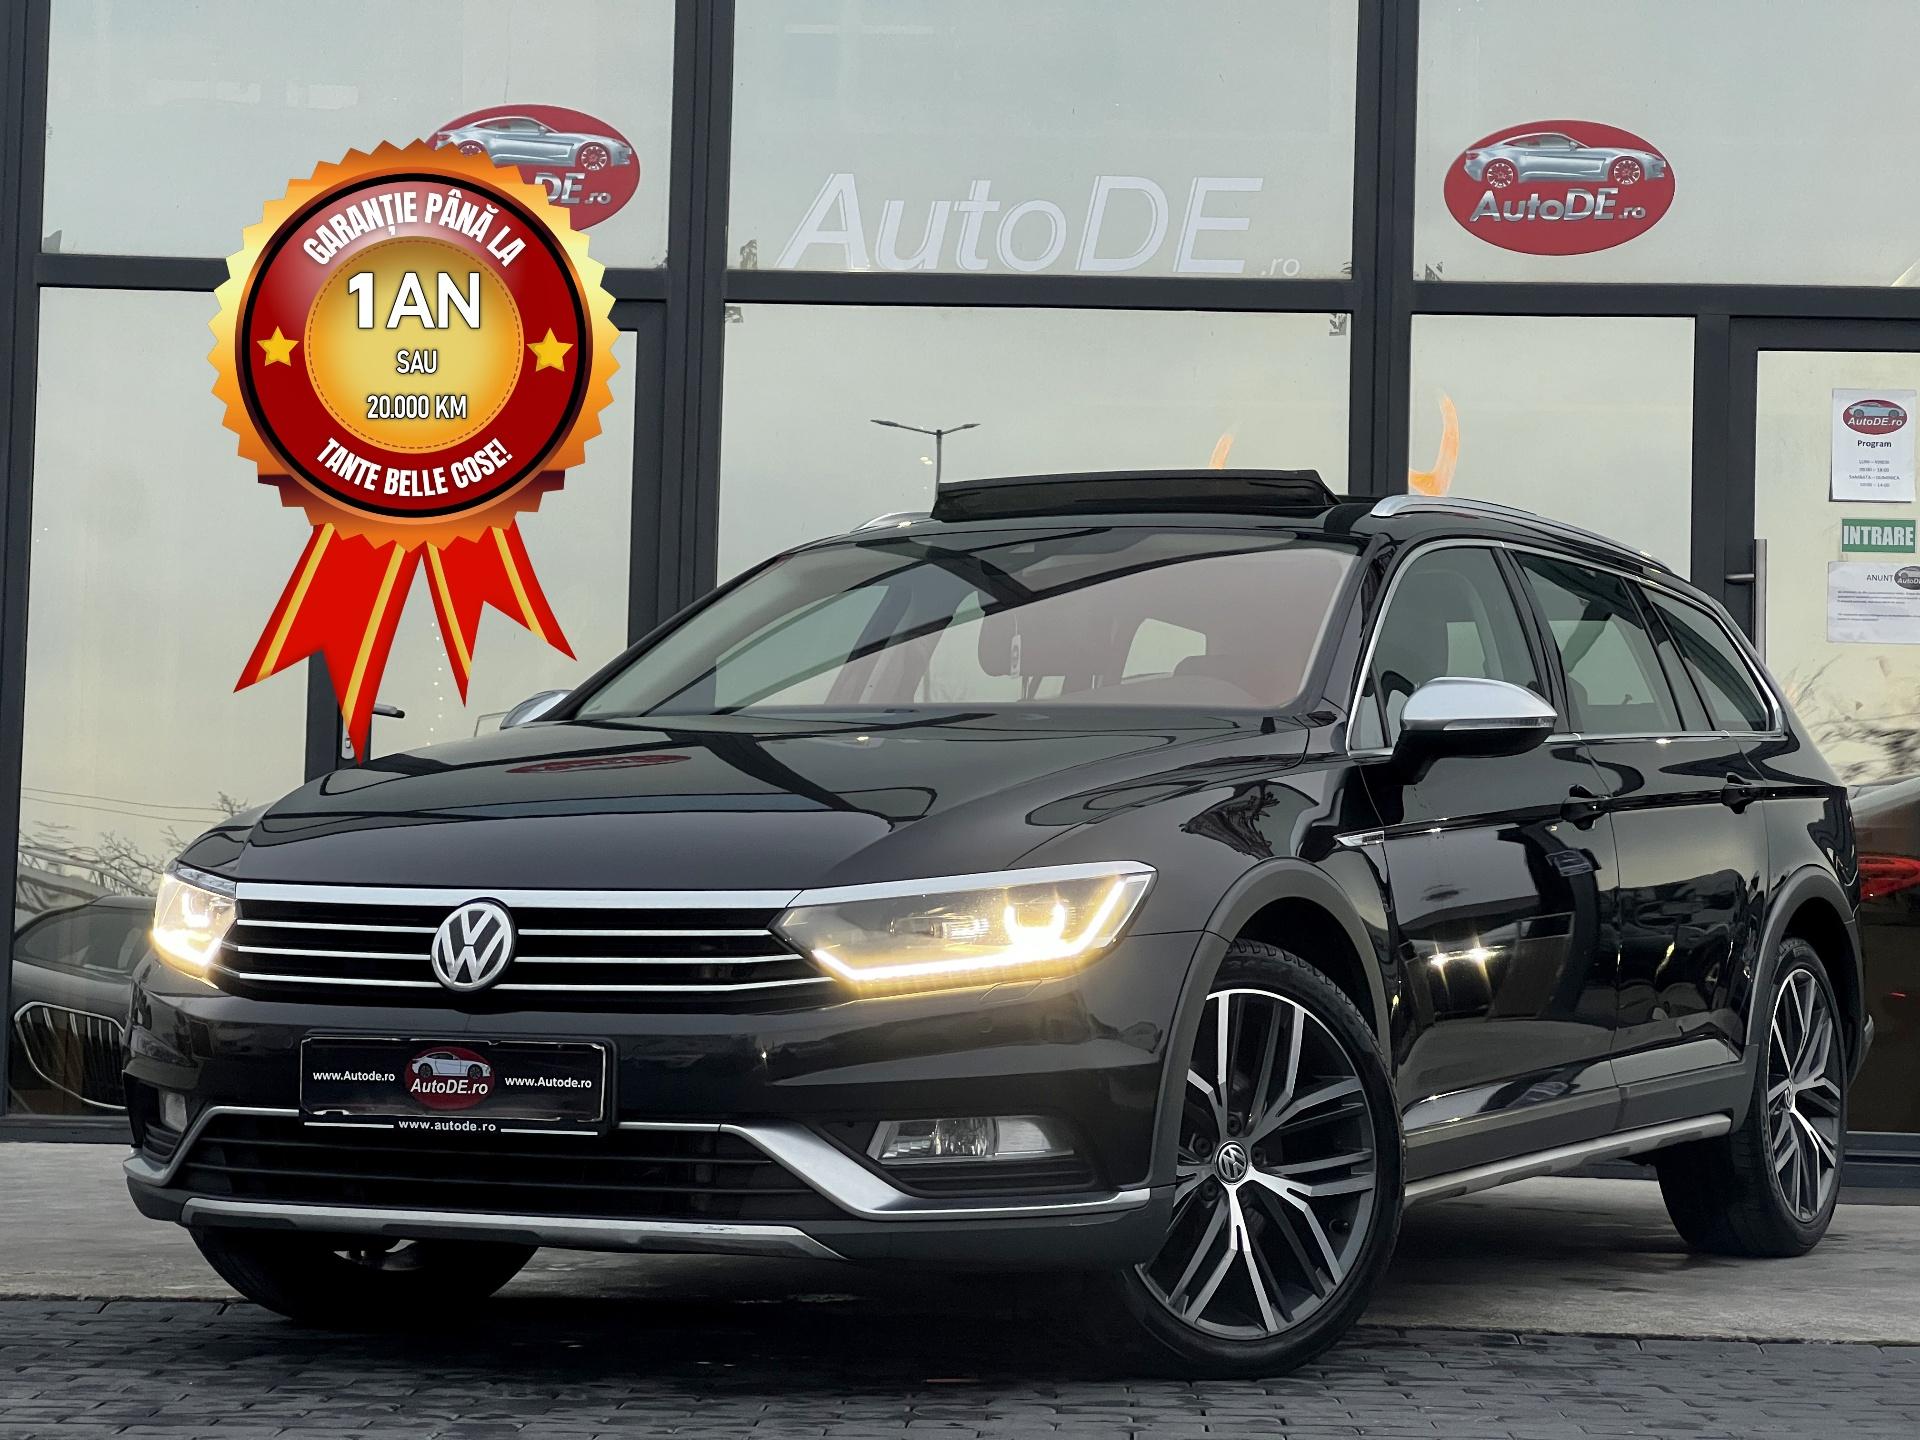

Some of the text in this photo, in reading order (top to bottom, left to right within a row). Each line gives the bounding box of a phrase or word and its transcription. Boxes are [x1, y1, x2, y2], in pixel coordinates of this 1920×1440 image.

[1847, 417, 1903, 426] AutoDE.ro
[1857, 440, 1892, 448] Program
[1843, 525, 1914, 546] INTRARE
[1866, 574, 1894, 582] ANUNT
[312, 1070, 593, 1095] www.Autode.ro AutoDE.ro www.Autode.ro
[398, 1119, 497, 1132] www.autode.ro
